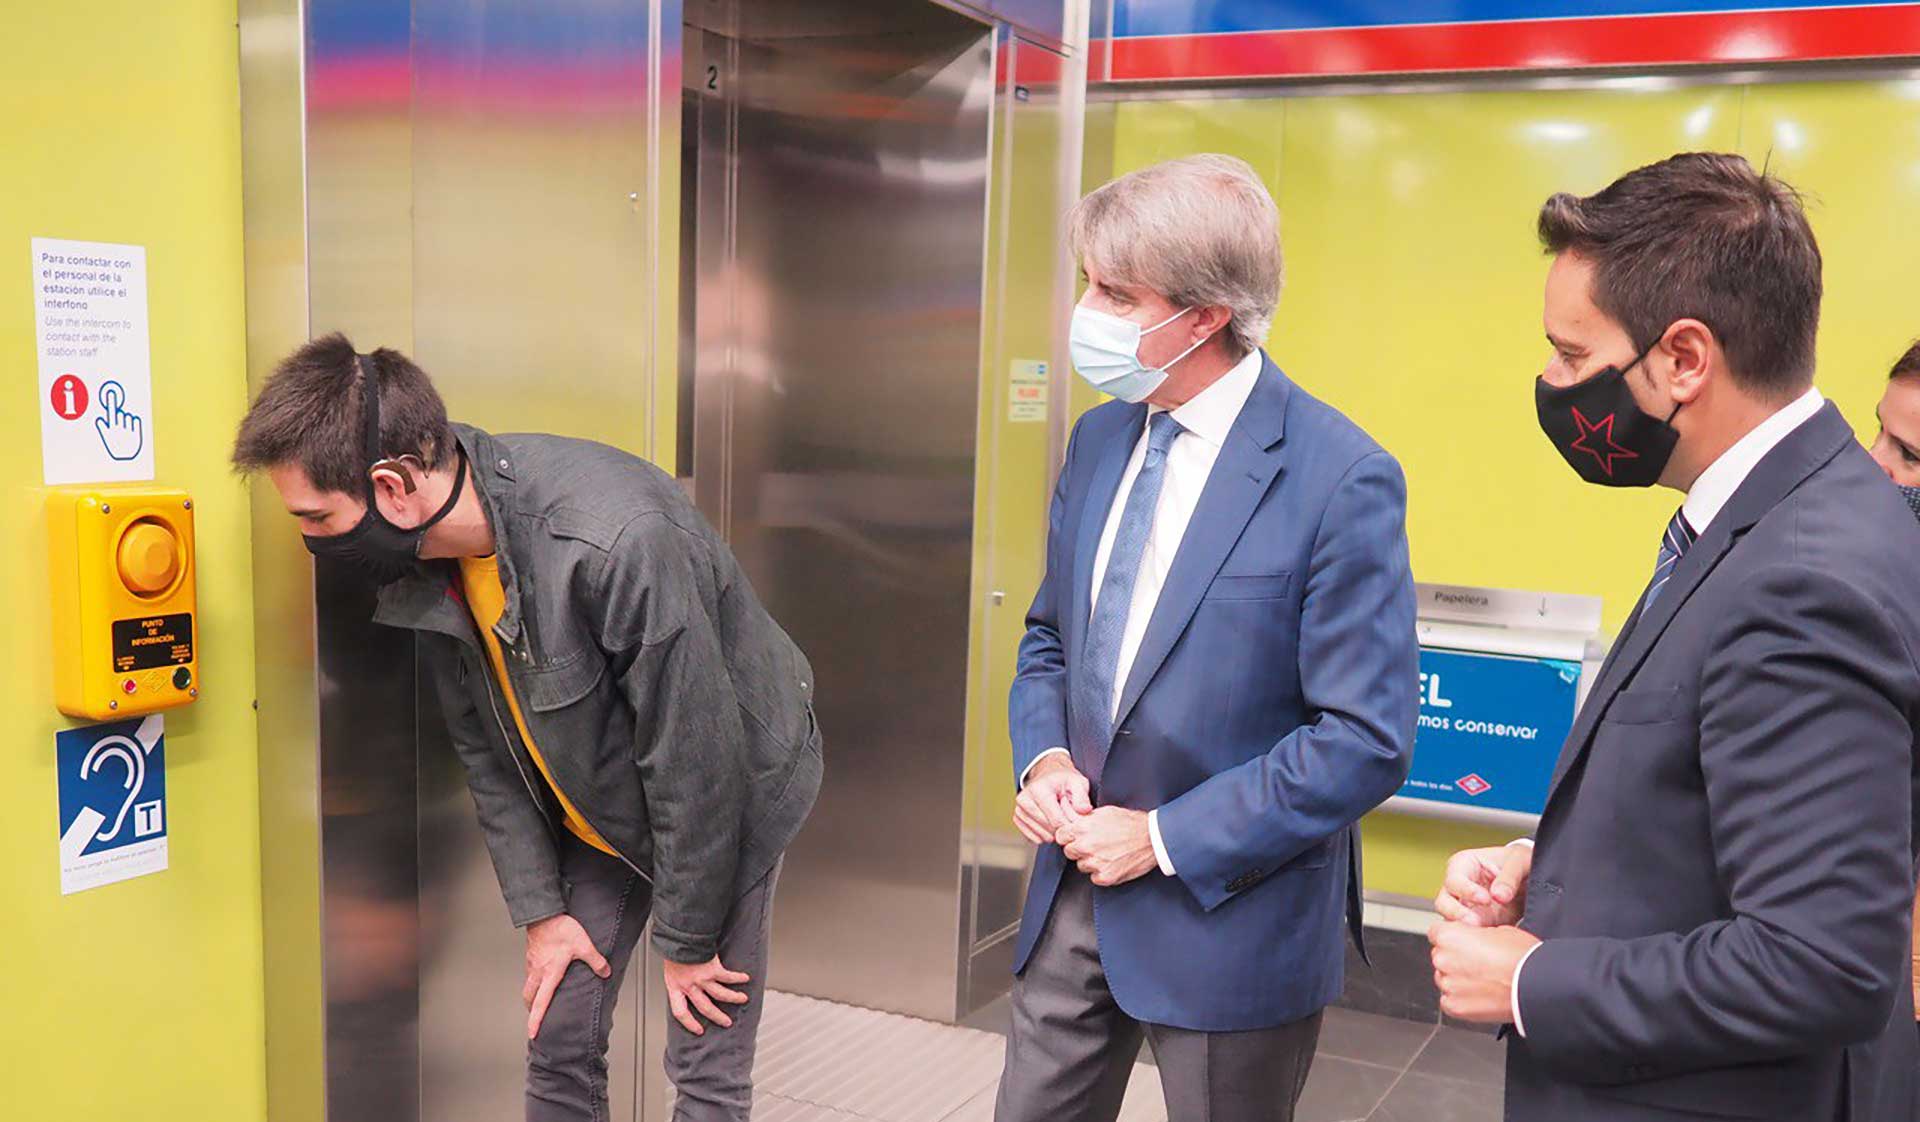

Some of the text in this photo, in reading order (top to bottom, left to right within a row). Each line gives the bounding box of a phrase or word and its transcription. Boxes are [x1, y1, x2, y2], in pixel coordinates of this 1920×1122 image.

[707, 65, 717, 89] 2
[42, 252, 131, 269] Para contactar con
[43, 269, 122, 282] el personal de la
[87, 286, 115, 296] utilice
[118, 288, 127, 297] el
[44, 299, 88, 310] interfono
[45, 315, 131, 329] Use the intercom to
[46, 332, 117, 343] contact with the
[47, 347, 98, 357] station staff
[1435, 591, 1488, 606] Papelera
[142, 618, 164, 628] PUNTO
[148, 628, 158, 636] DE
[1454, 719, 1538, 740] conservar
[139, 804, 156, 831] T
